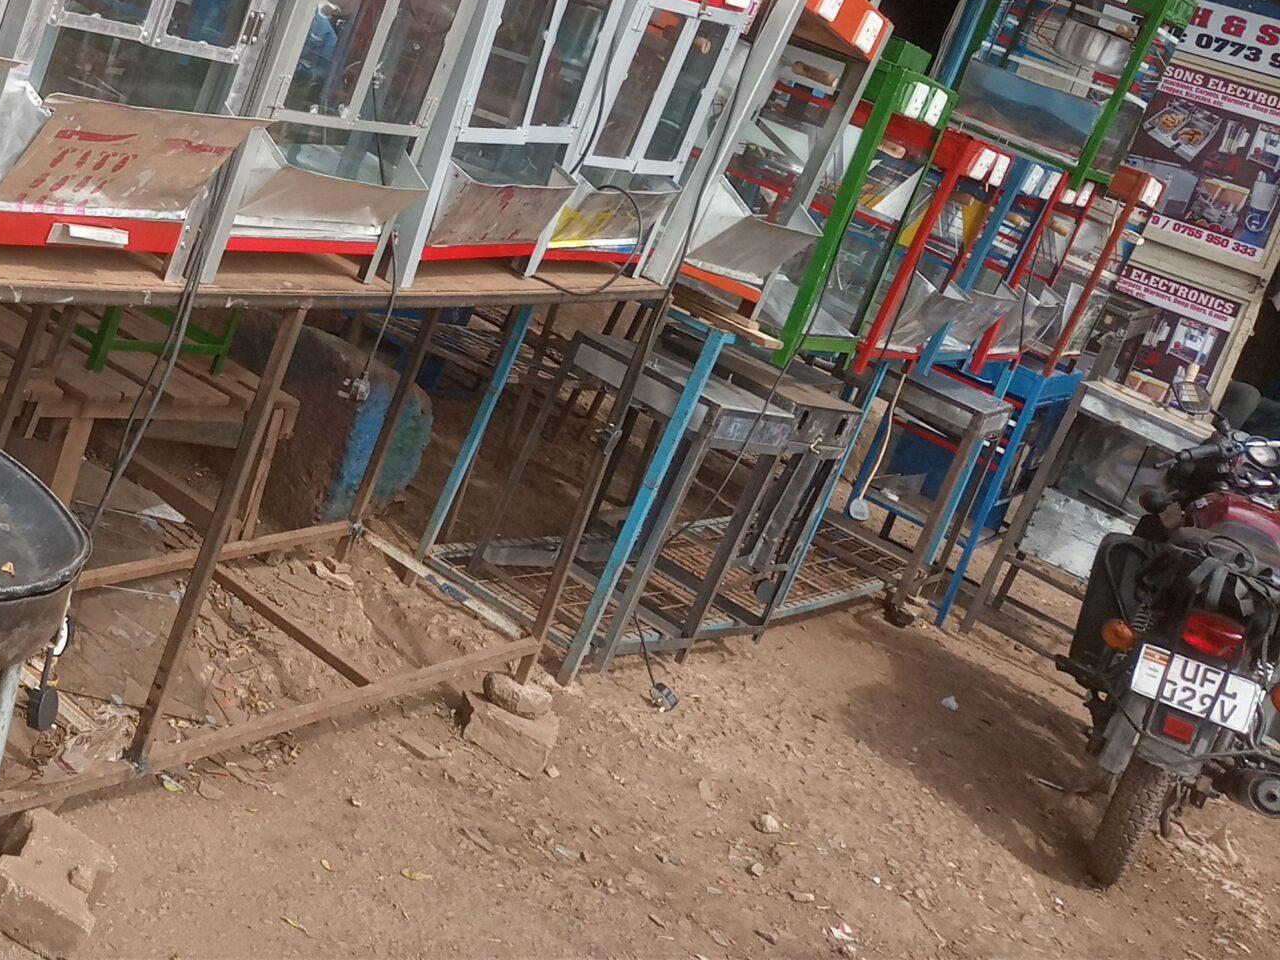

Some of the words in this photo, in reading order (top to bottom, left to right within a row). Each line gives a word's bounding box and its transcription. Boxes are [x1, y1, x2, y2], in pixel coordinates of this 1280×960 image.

[1221, 15, 1248, 38] &
[1195, 33, 1263, 63] 0773
[1164, 65, 1205, 86] SONS
[1207, 77, 1280, 109] ELECTRO
[1172, 222, 1203, 240] 0755
[1205, 234, 1231, 249] 950
[1231, 242, 1258, 258] 333
[1130, 268, 1236, 316] ELECTRONICS
